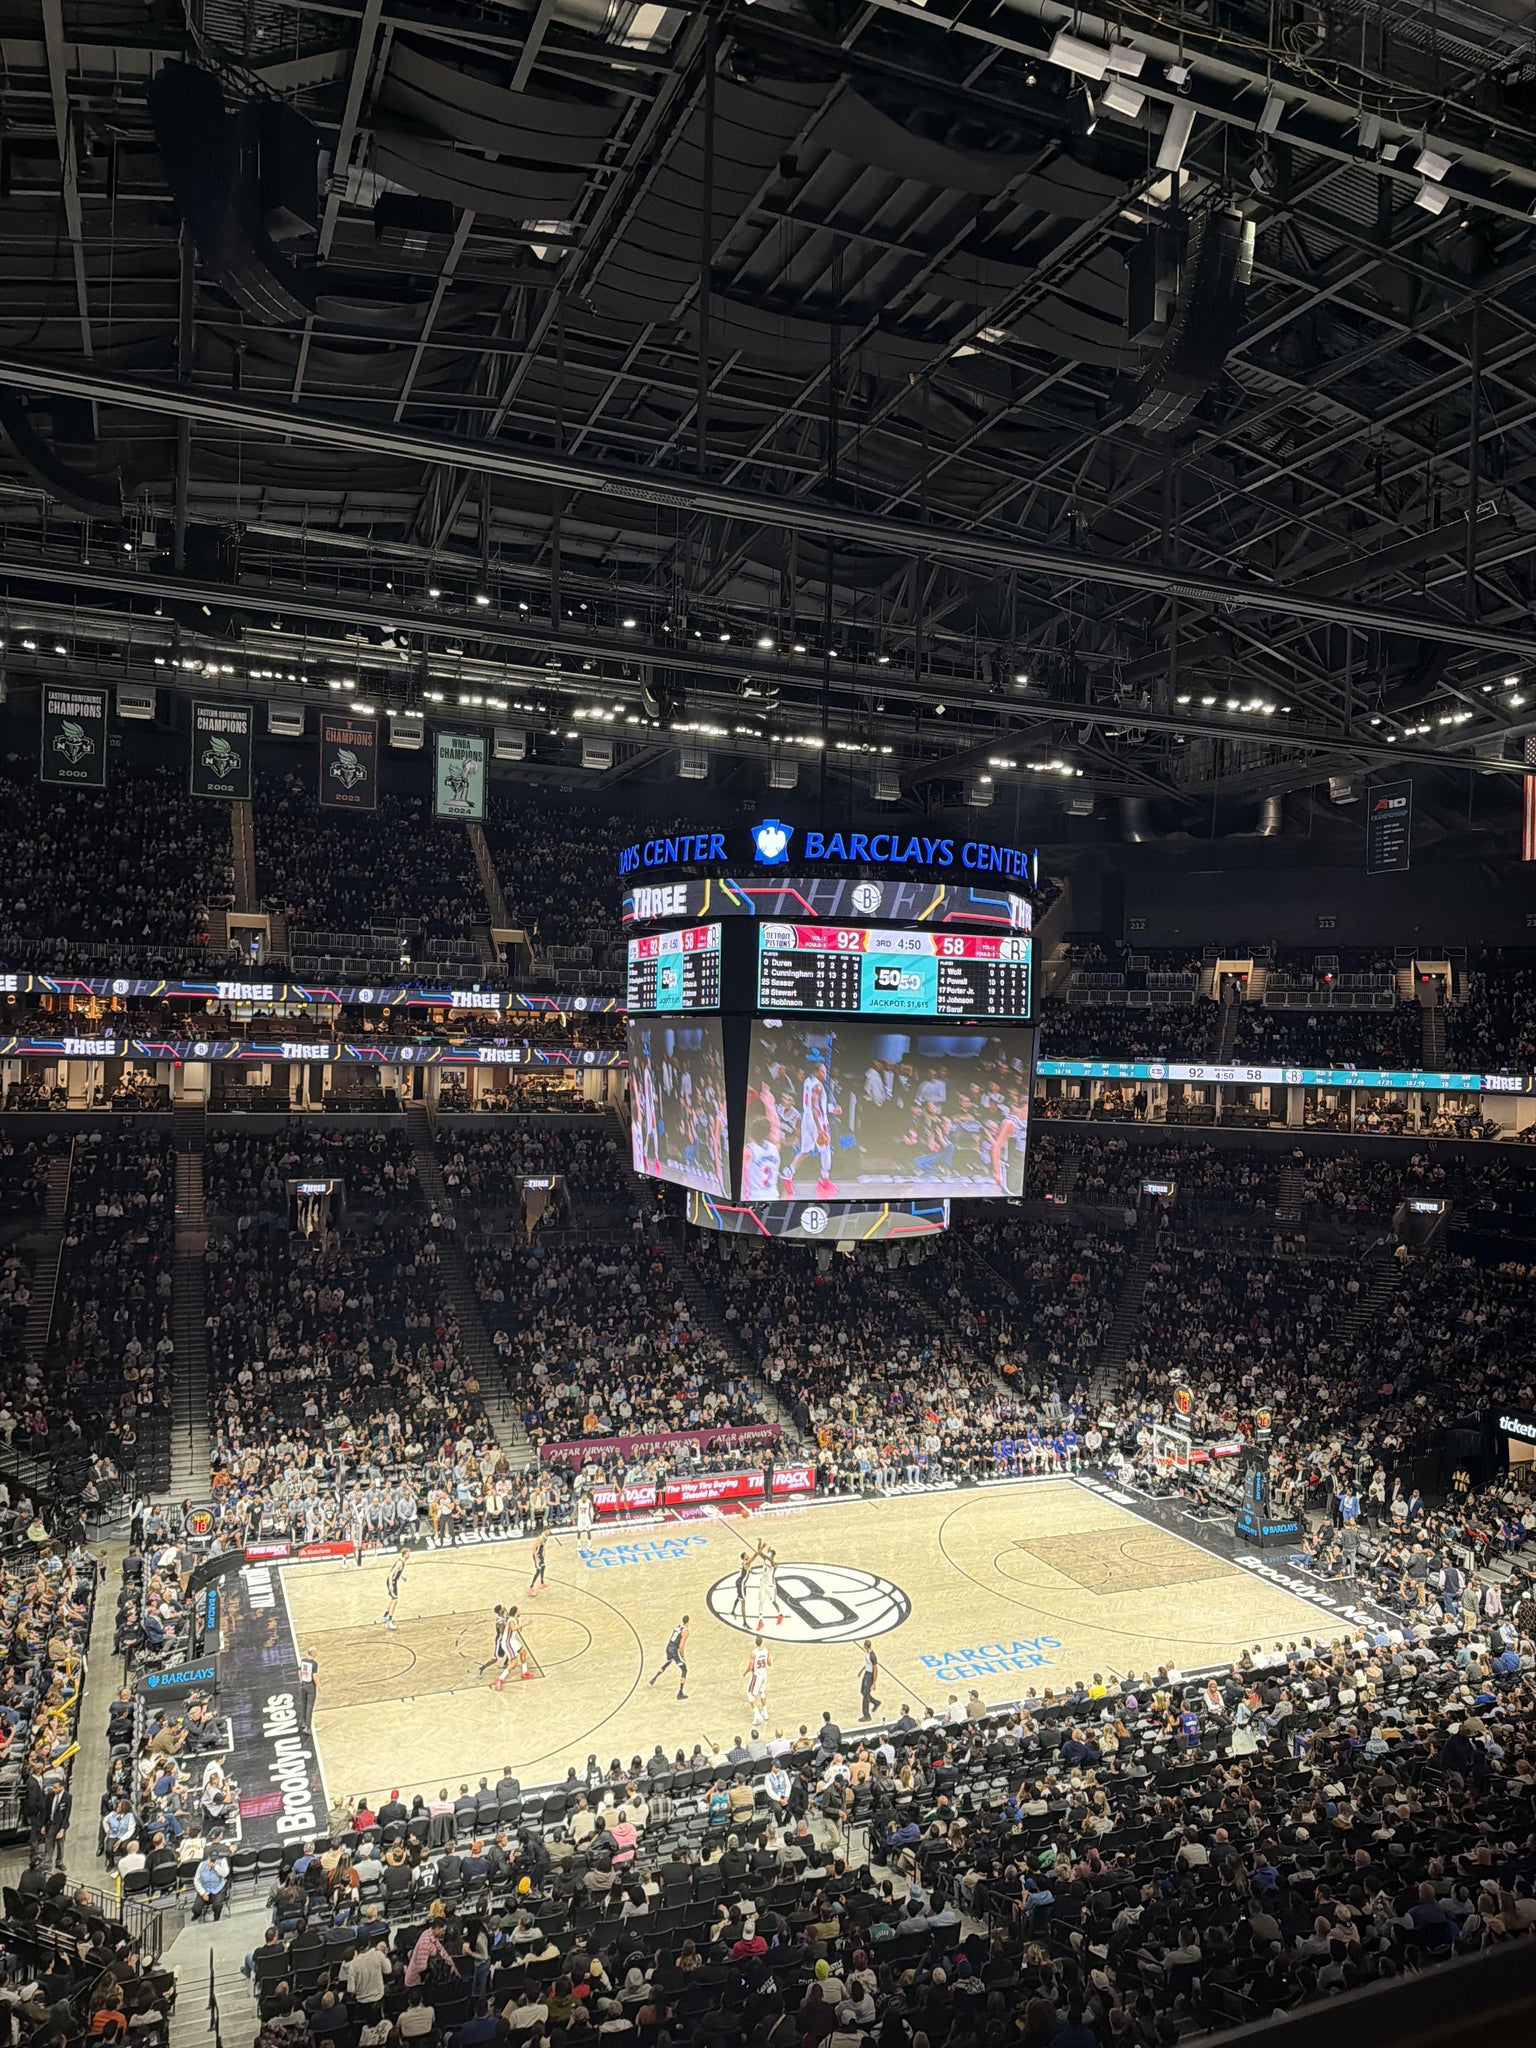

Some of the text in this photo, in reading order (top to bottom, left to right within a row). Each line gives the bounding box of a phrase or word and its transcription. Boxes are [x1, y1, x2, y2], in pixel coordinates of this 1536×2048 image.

[48, 692, 102, 704] EASTERN CONFERENCE
[48, 701, 102, 718] CHAMPIONS
[197, 708, 247, 720] EASTERN CONFERENCE
[197, 717, 247, 734] CHAMPIONS
[326, 730, 373, 746] CHAMPIONS
[452, 738, 470, 749] WNBA
[440, 747, 482, 762] CHAMPIONS
[59, 770, 87, 778] 2000
[207, 784, 234, 792] 2002
[1372, 798, 1406, 812] A10
[643, 833, 728, 867] CENTER
[805, 832, 1029, 879] BARCLAYS CENTER
[633, 884, 687, 919] THREE
[650, 939, 657, 954] 92
[685, 932, 694, 950] 58
[765, 939, 791, 948] PISTONS
[766, 932, 791, 940] DETROIT
[837, 932, 859, 949] 92
[898, 940, 921, 950] 4:50
[943, 938, 964, 955] 58
[771, 970, 814, 978] Cunningham
[879, 969, 900, 985] 50
[216, 982, 273, 999] THREE
[451, 992, 500, 1008] THREE
[63, 1038, 115, 1054] THREE
[281, 1043, 329, 1058] THREE
[479, 1048, 520, 1063] THREE
[1189, 1068, 1204, 1078] 92
[1246, 1070, 1262, 1080] 58
[1485, 1075, 1522, 1091] THREE
[550, 1445, 615, 1458] QATAR AIRWAY
[631, 1442, 660, 1451] QATAR
[666, 1479, 738, 1493] The Way Tire Buying
[776, 1472, 810, 1487] RACK
[621, 1488, 656, 1501] RACK
[682, 1490, 707, 1500] Should
[1270, 1523, 1298, 1533] BARCLAYS
[578, 1536, 708, 1559] BARCLAYS
[585, 1549, 694, 1568] CENTER
[1234, 1556, 1336, 1606] Brooklyn
[919, 1635, 1063, 1669] BARCLAYS
[935, 1652, 1055, 1682] CENTER
[161, 1668, 214, 1685] BARCLAYS
[262, 1693, 316, 1834] Brooklyn Nets
